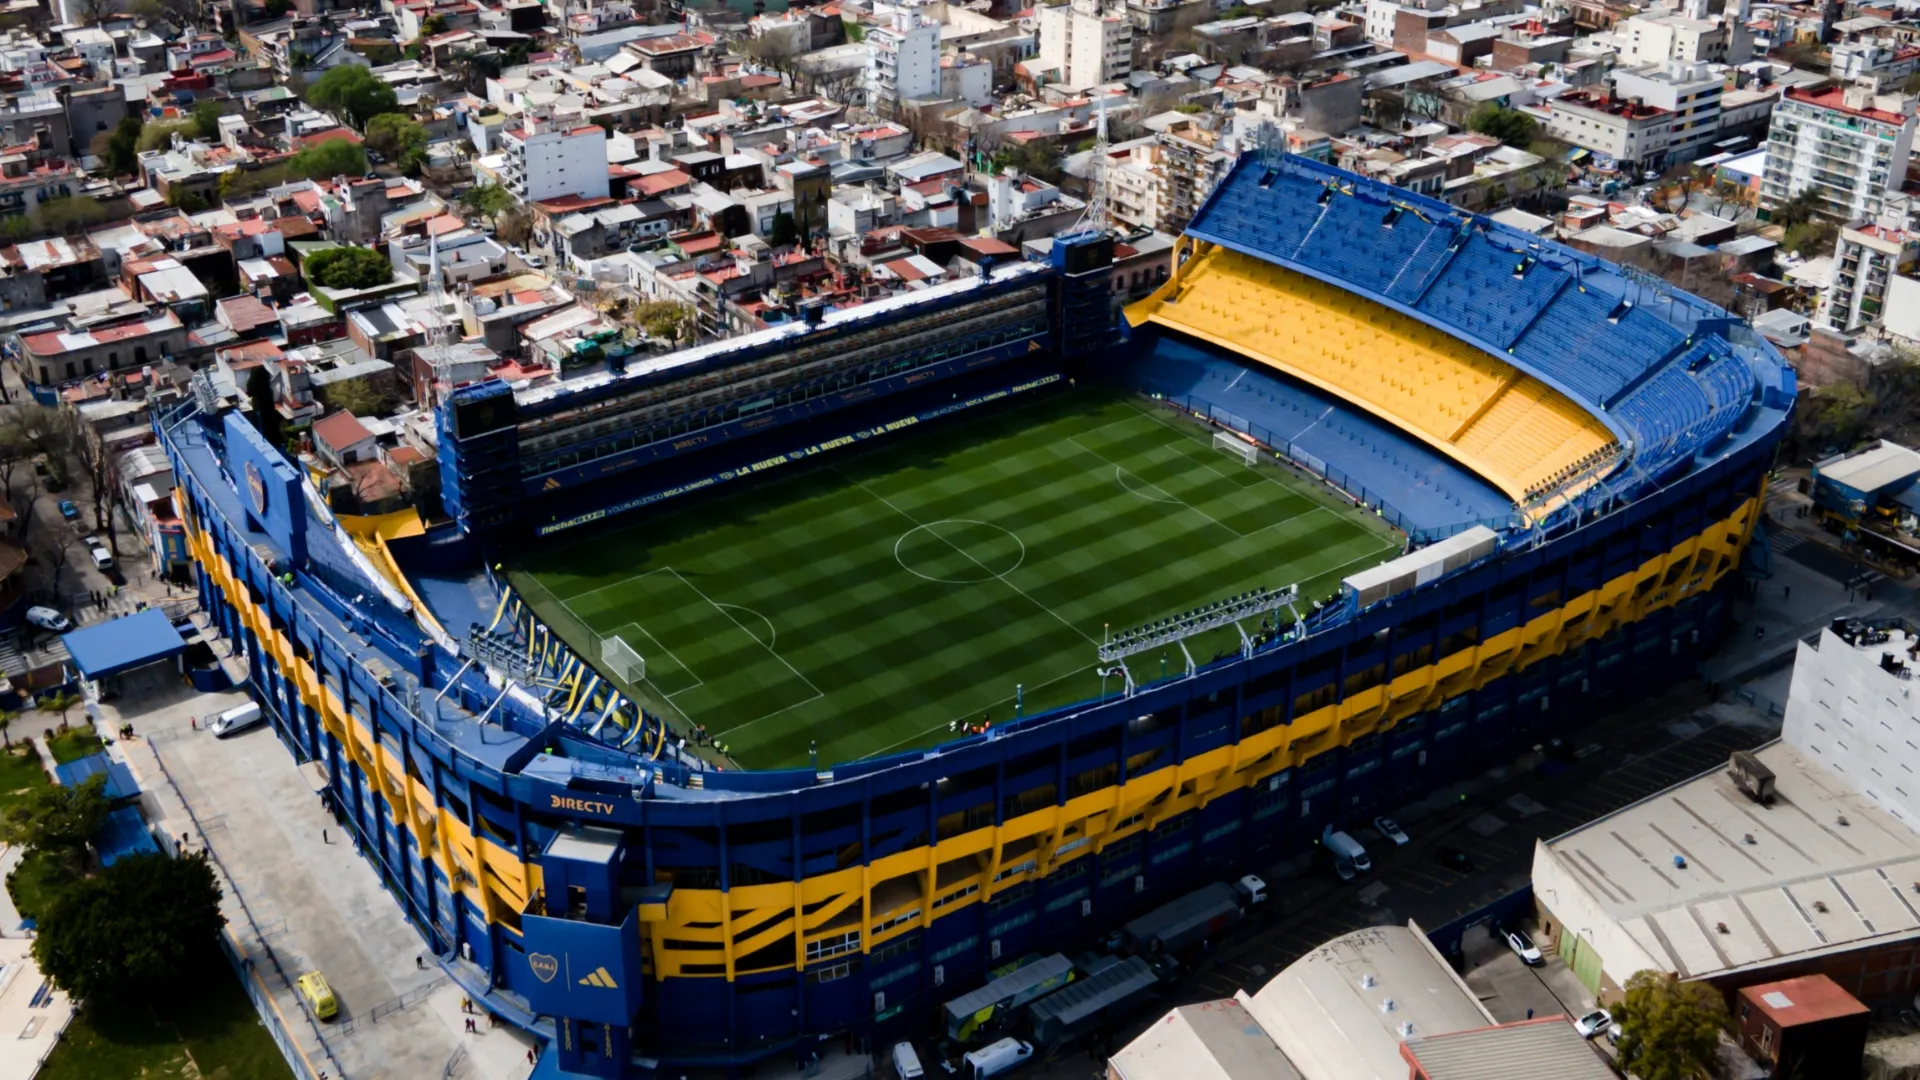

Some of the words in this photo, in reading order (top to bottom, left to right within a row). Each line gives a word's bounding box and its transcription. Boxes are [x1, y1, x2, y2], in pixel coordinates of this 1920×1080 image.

[871, 426, 885, 436] LA
[885, 415, 919, 431] NUEVA
[672, 435, 708, 450] DIRECTV
[804, 445, 820, 455] LA
[820, 435, 855, 451] NUEVA
[735, 466, 751, 476] LA
[751, 455, 788, 472] NUEVA
[663, 486, 684, 498] BOCA
[551, 795, 614, 815] DIRECTV
